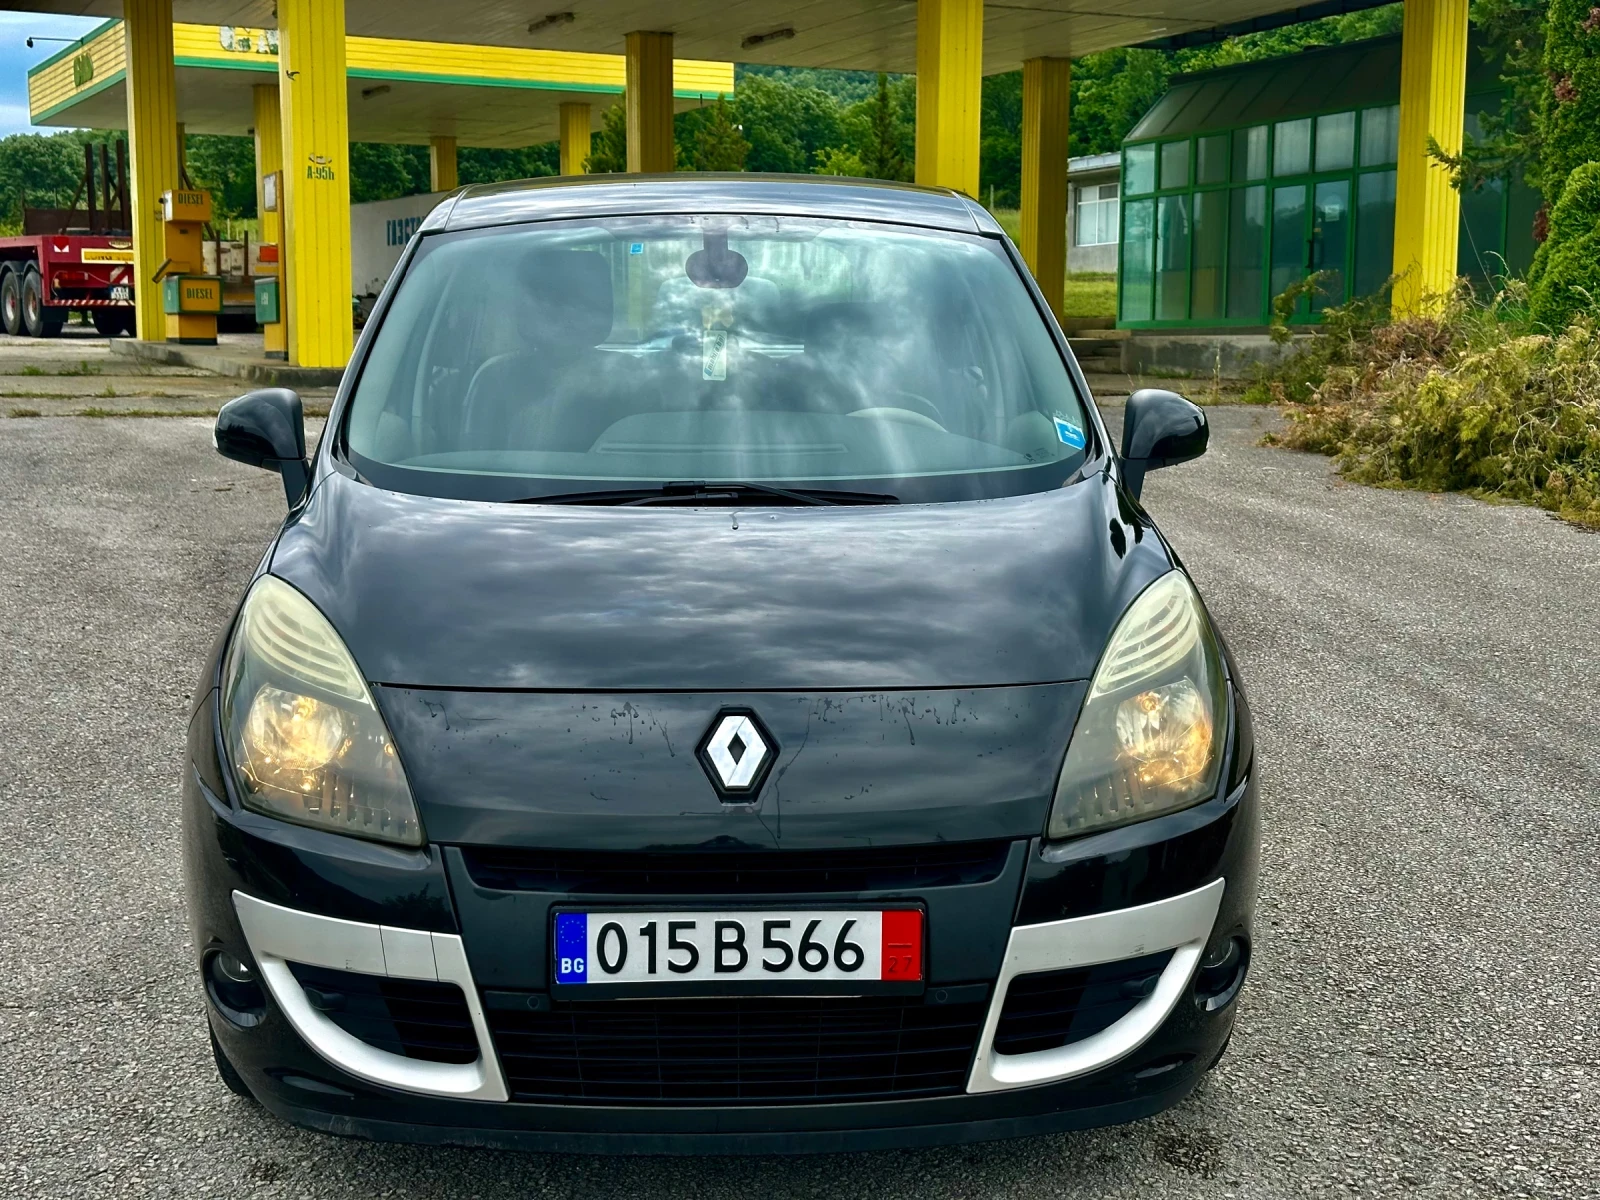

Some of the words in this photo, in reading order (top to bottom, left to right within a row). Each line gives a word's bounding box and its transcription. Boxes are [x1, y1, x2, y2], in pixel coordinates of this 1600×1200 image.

[178, 194, 204, 205] DIESEL
[187, 288, 213, 299] DIESEL
[561, 958, 585, 974] BG
[887, 955, 912, 974] 27
